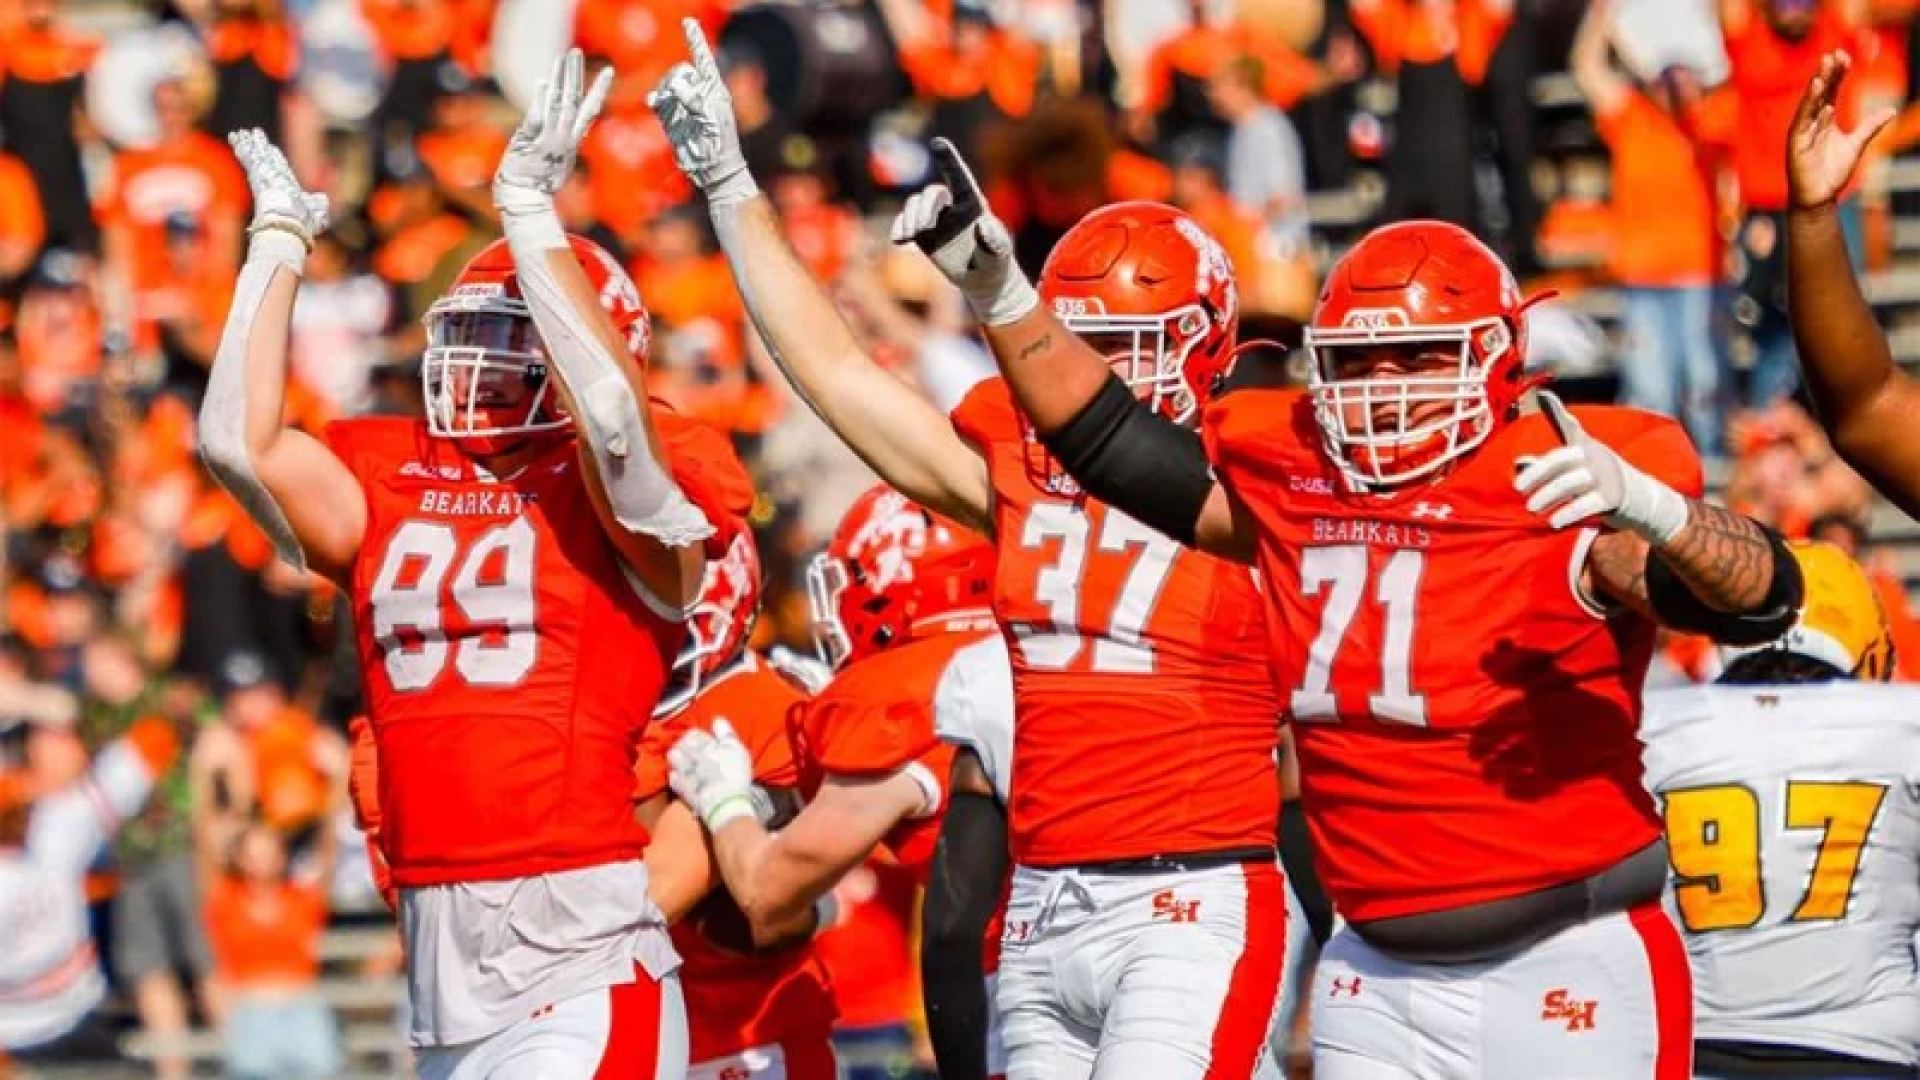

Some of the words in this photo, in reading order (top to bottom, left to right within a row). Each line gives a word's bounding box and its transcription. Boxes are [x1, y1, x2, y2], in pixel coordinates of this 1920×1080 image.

[419, 489, 538, 515] BEARKAT
[1312, 518, 1431, 546] BEARKATS
[369, 518, 540, 692] 89
[1011, 502, 1184, 673] 37
[1291, 544, 1427, 728] 71
[1659, 778, 1892, 935] 97
[1540, 987, 1600, 1033] SH
